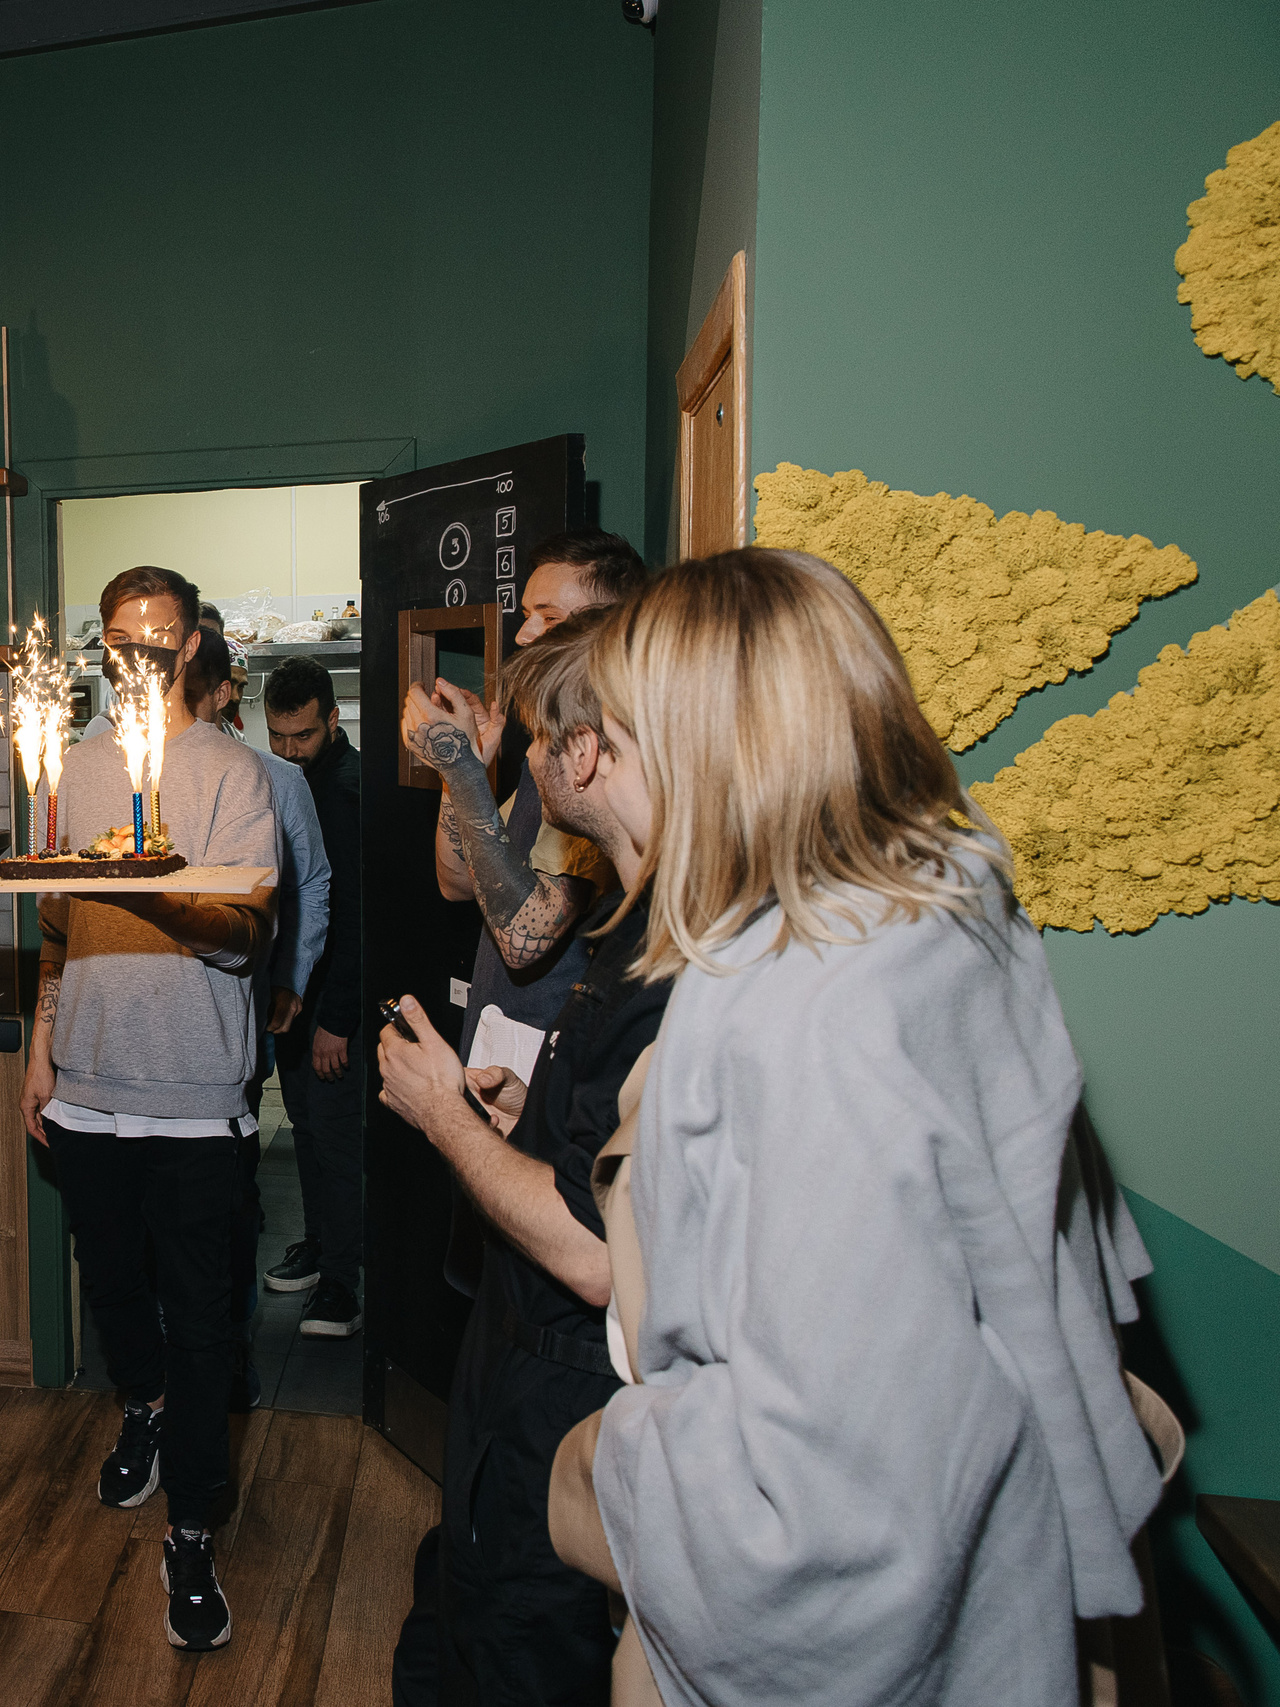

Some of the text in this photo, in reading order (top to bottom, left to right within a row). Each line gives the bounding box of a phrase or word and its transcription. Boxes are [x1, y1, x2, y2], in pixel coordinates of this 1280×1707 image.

[495, 479, 514, 494] 100
[377, 507, 391, 525] 106
[501, 513, 512, 530] 5
[451, 537, 460, 555] 3
[500, 554, 510, 572] 6
[452, 588, 459, 604] 8
[501, 591, 511, 607] 7
